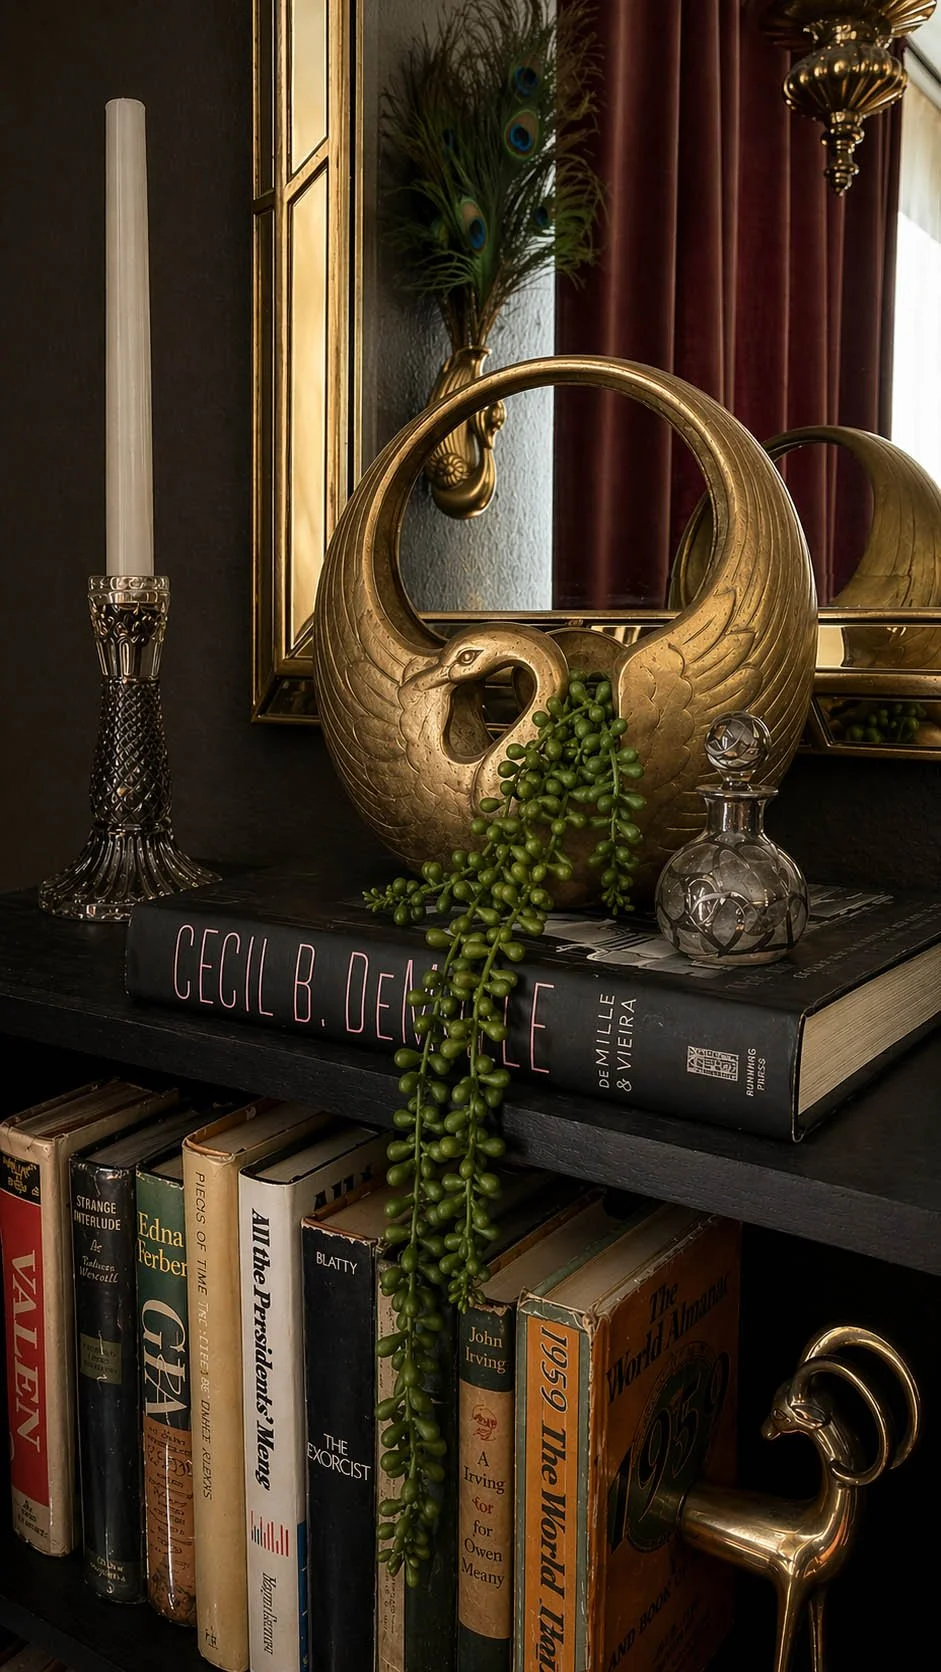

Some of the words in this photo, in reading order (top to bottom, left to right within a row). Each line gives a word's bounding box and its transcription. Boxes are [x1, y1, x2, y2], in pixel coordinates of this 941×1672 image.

[174, 924, 274, 1018] CECIL
[293, 943, 326, 1028] B.
[616, 998, 637, 1071] VIEIRA
[616, 1077, 632, 1092] &
[76, 1194, 117, 1215] STRANGE
[137, 1211, 184, 1248] Edna
[196, 1230, 207, 1252] OF
[252, 1207, 270, 1247] All
[137, 1237, 188, 1277] Ferber
[253, 1248, 271, 1285] the
[316, 1251, 358, 1275] BLATTY
[197, 1259, 208, 1297] TIME
[650, 1282, 679, 1325] The
[11, 1249, 41, 1453] VALEN
[469, 1326, 502, 1348] John
[465, 1346, 506, 1375] Irving
[540, 1324, 567, 1414] 1959
[605, 1321, 664, 1404] World
[255, 1419, 275, 1491] Meng
[307, 1441, 371, 1481] EXORCIST
[323, 1433, 348, 1456] THE
[477, 1450, 489, 1467] A
[541, 1420, 567, 1486] The
[463, 1465, 506, 1495] Irving
[473, 1519, 493, 1538] for
[540, 1487, 566, 1600] World
[464, 1537, 503, 1562] Owen
[461, 1556, 505, 1590] Meany
